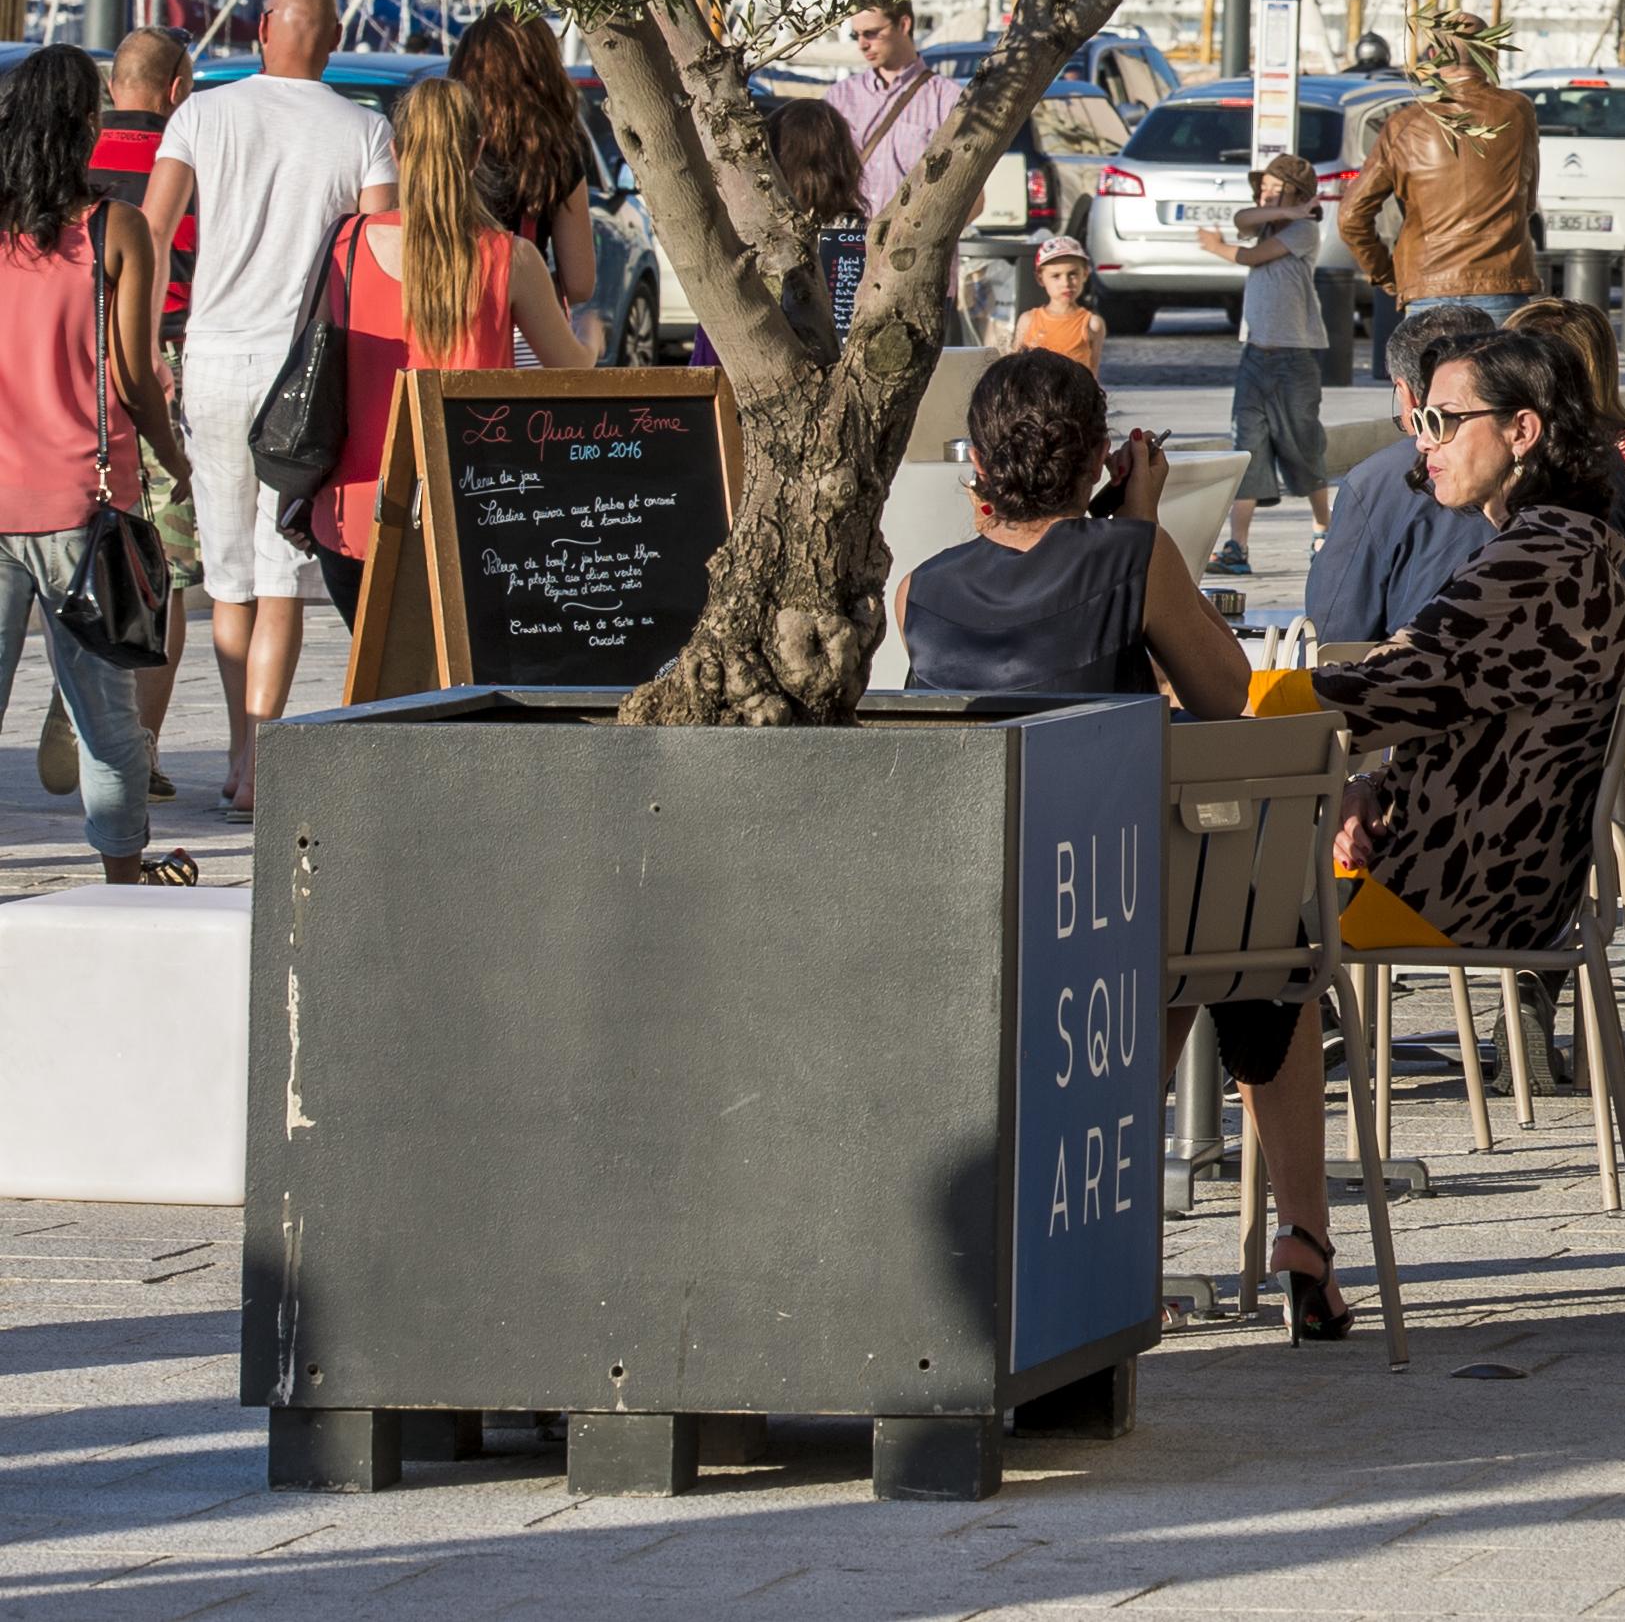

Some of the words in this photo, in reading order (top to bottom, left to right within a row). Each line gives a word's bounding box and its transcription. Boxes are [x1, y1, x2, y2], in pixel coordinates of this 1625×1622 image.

[463, 405, 512, 443] Le
[527, 410, 585, 462] Quai
[593, 411, 623, 439] du
[570, 444, 601, 460] EURO
[608, 441, 642, 459] 2016
[459, 465, 495, 491] Menu
[499, 469, 515, 484] du
[571, 504, 592, 516] aux
[628, 493, 639, 510] et
[580, 515, 595, 528] de
[600, 512, 643, 526] tomates
[524, 556, 540, 570] de
[588, 634, 627, 647] Chocolat
[1056, 824, 1138, 939] BLU
[1055, 968, 1137, 1089] SQU
[1048, 1114, 1135, 1238] ARE
